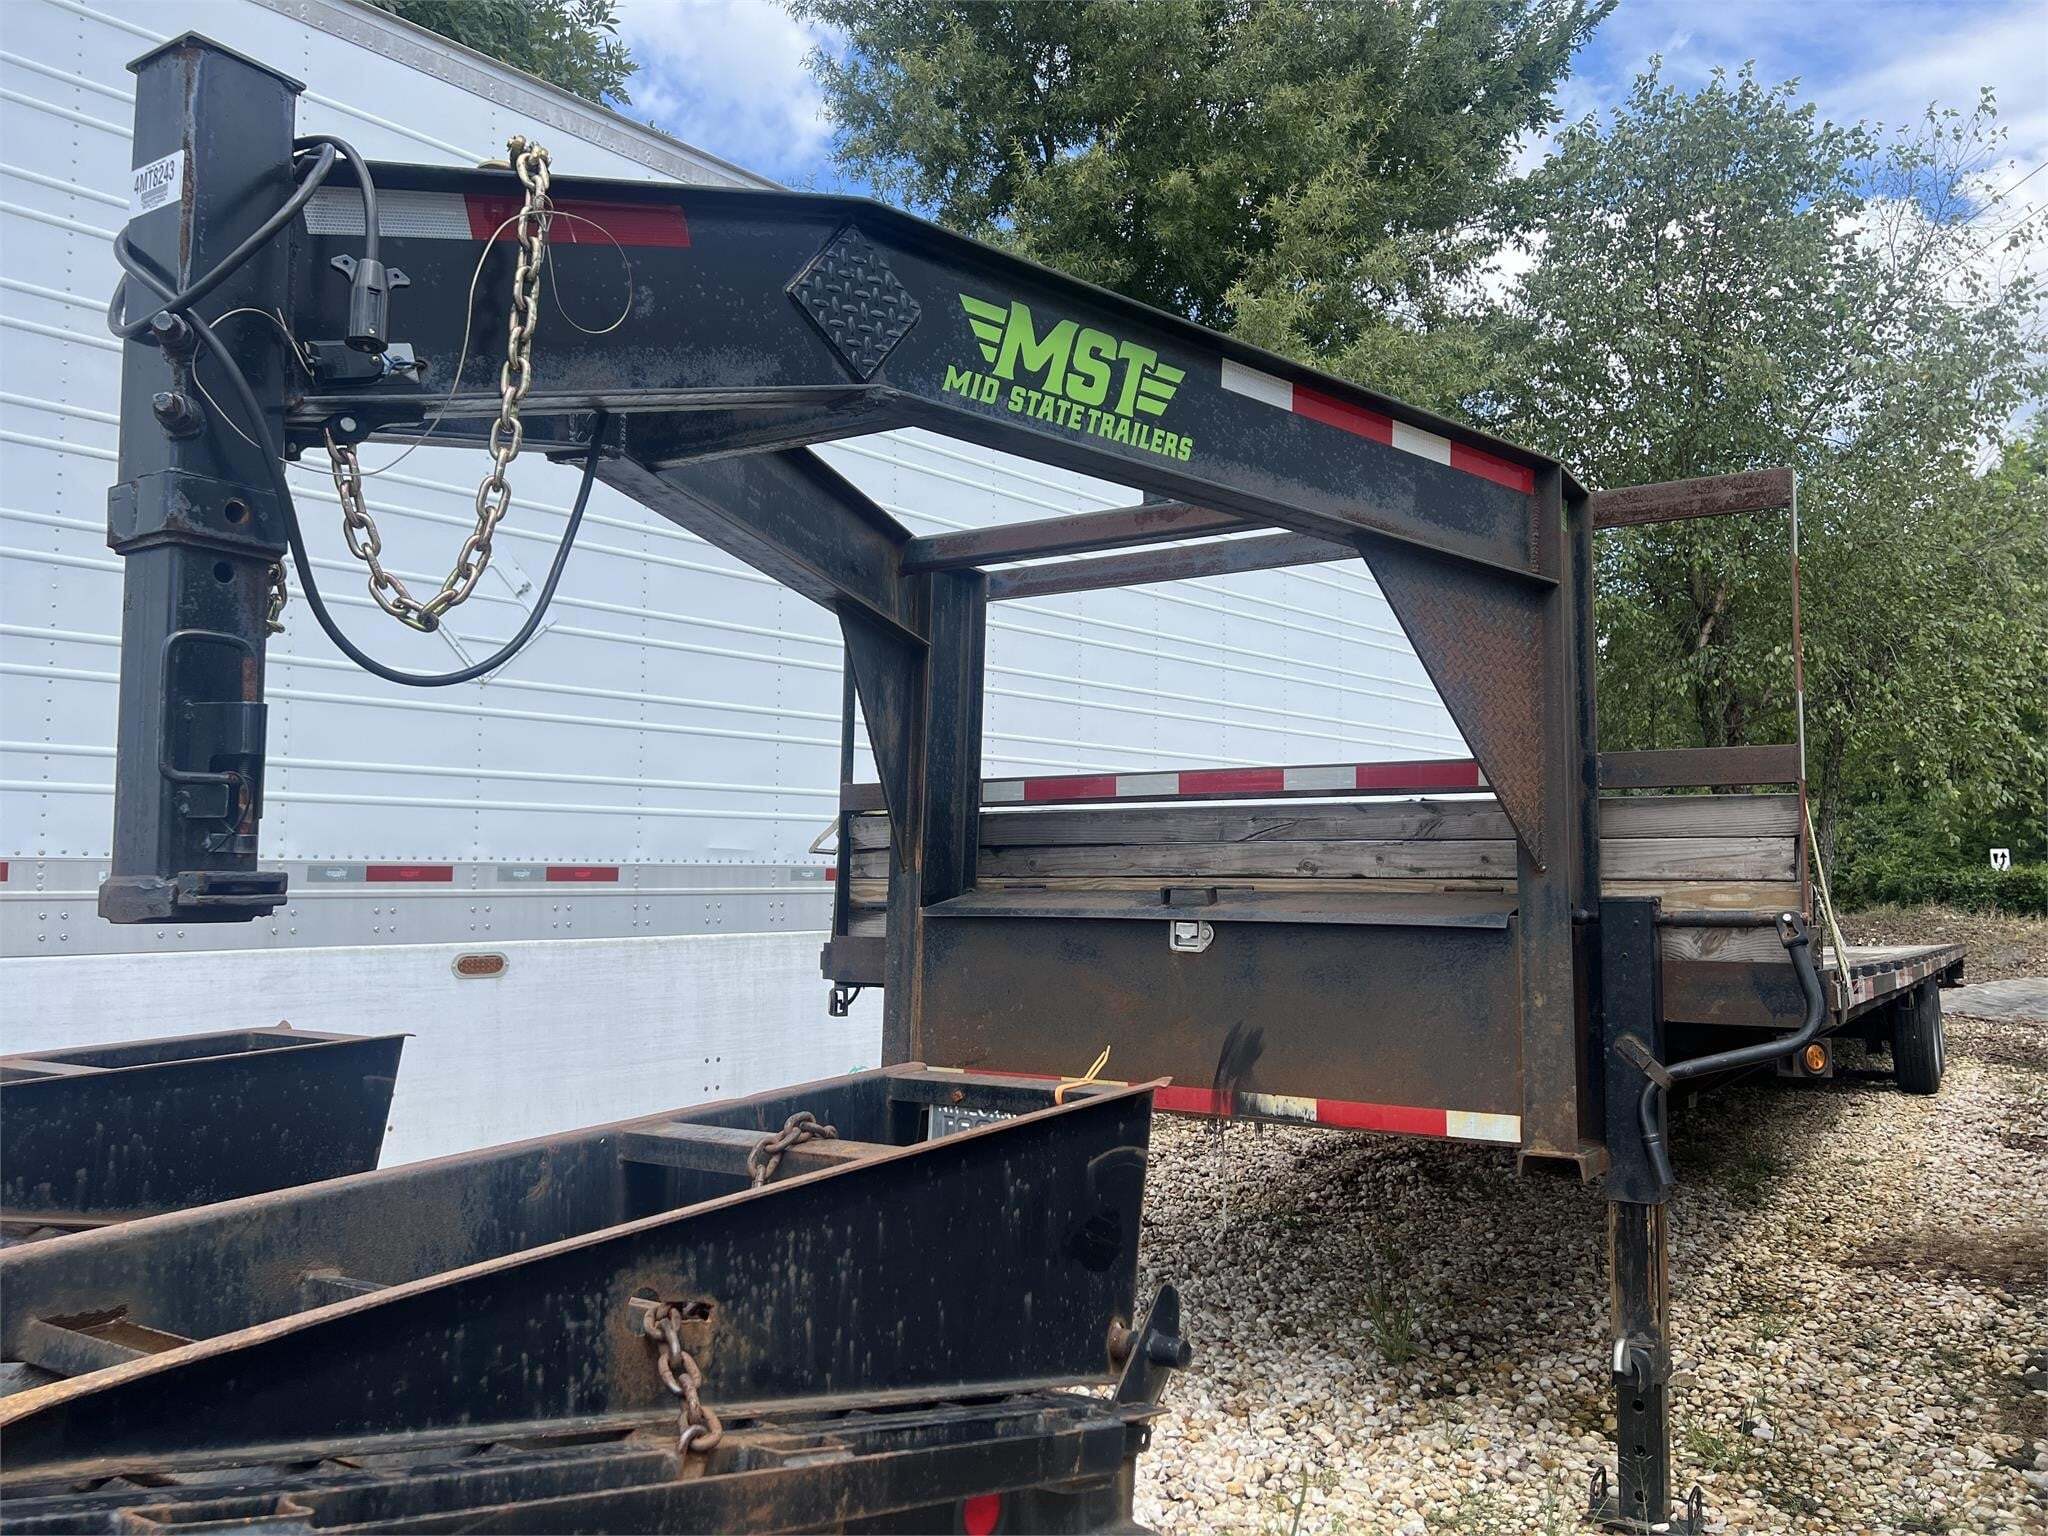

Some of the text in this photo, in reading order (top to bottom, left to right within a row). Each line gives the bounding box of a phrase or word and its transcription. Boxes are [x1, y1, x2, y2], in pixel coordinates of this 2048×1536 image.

[134, 161, 174, 195] 4MT8243
[993, 301, 1157, 417] MST
[942, 365, 1194, 461] MID STATE TRAILERS
